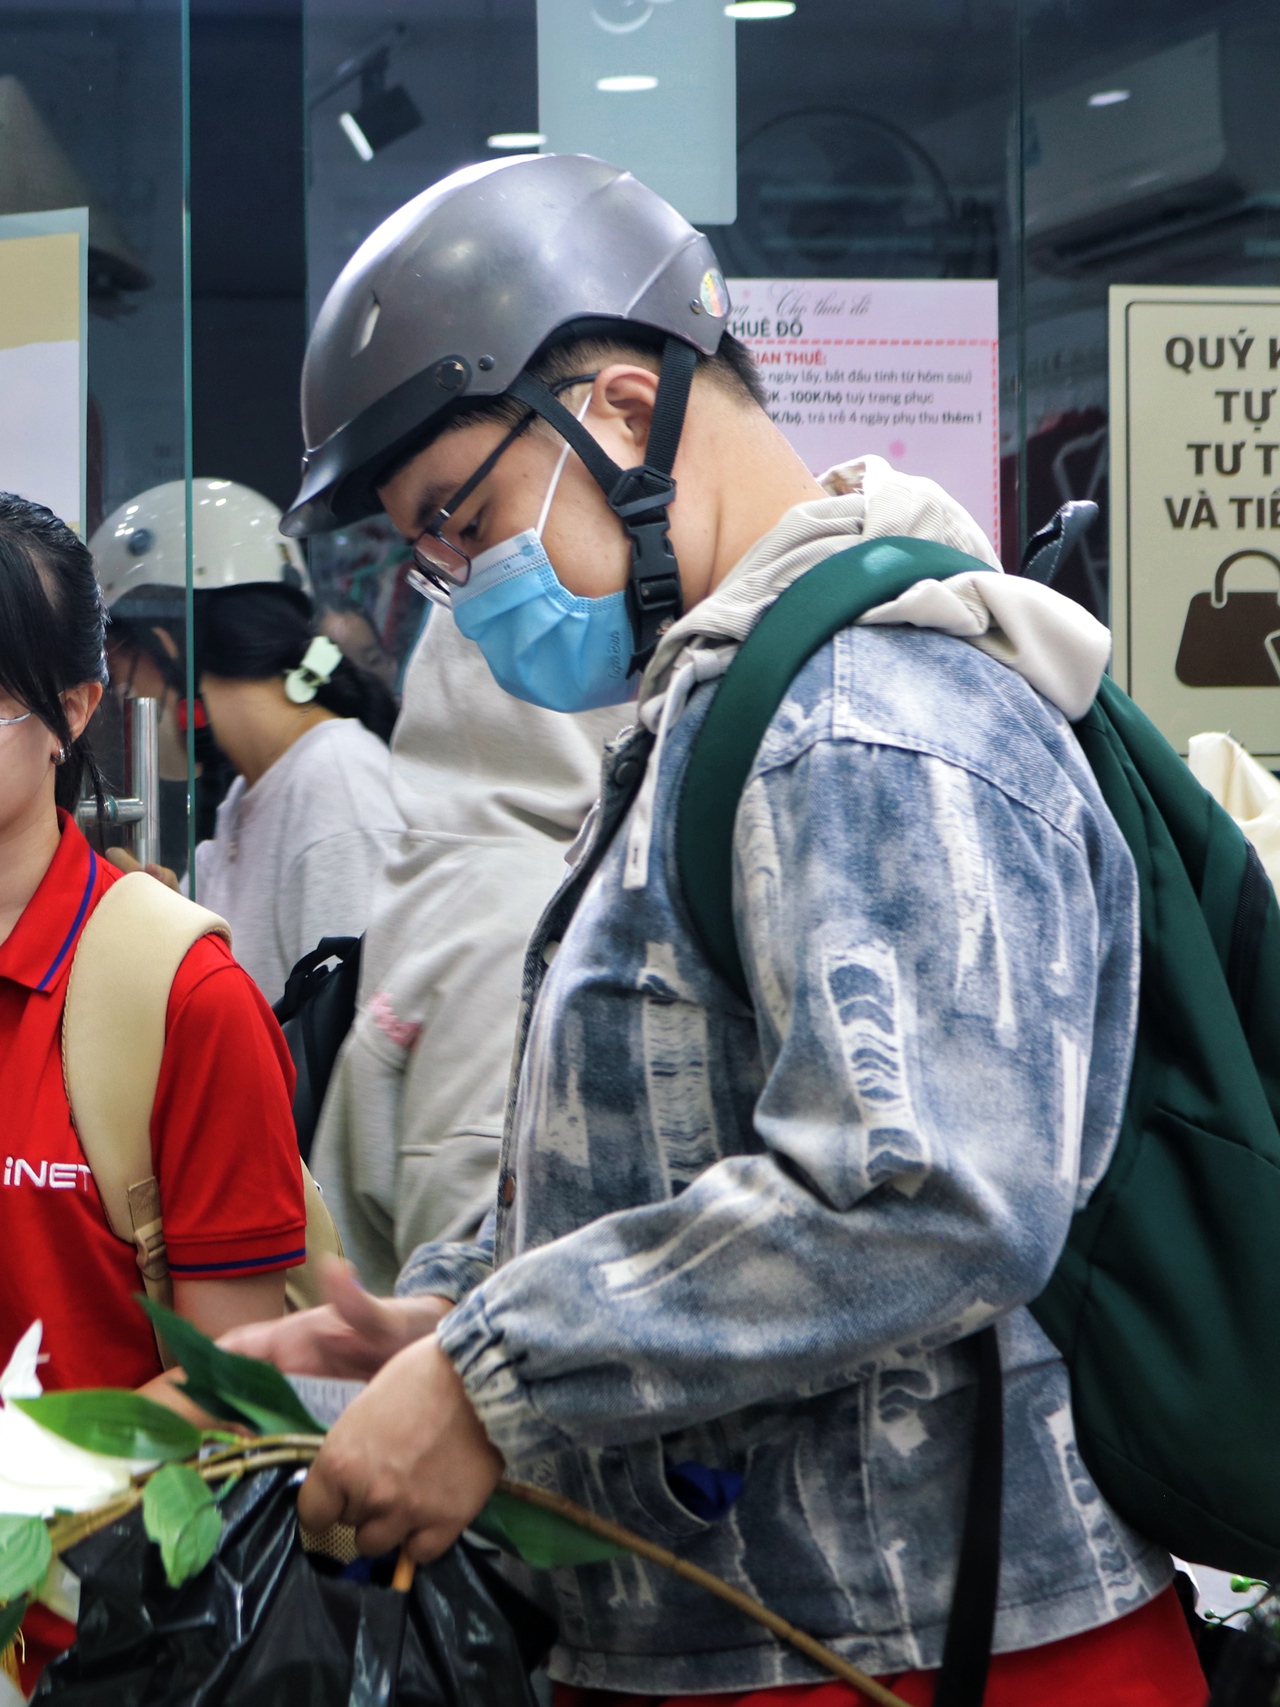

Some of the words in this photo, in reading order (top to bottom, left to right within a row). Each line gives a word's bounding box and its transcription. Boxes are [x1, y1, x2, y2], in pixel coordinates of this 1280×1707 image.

[776, 316, 803, 337] ĐỒ
[754, 352, 780, 365] IAN
[1165, 328, 1255, 375] QUÝ
[1215, 388, 1277, 432] TỰ
[1187, 441, 1246, 477] TƯ
[1164, 489, 1218, 530] VÀ
[4, 1157, 91, 1191] iNET
